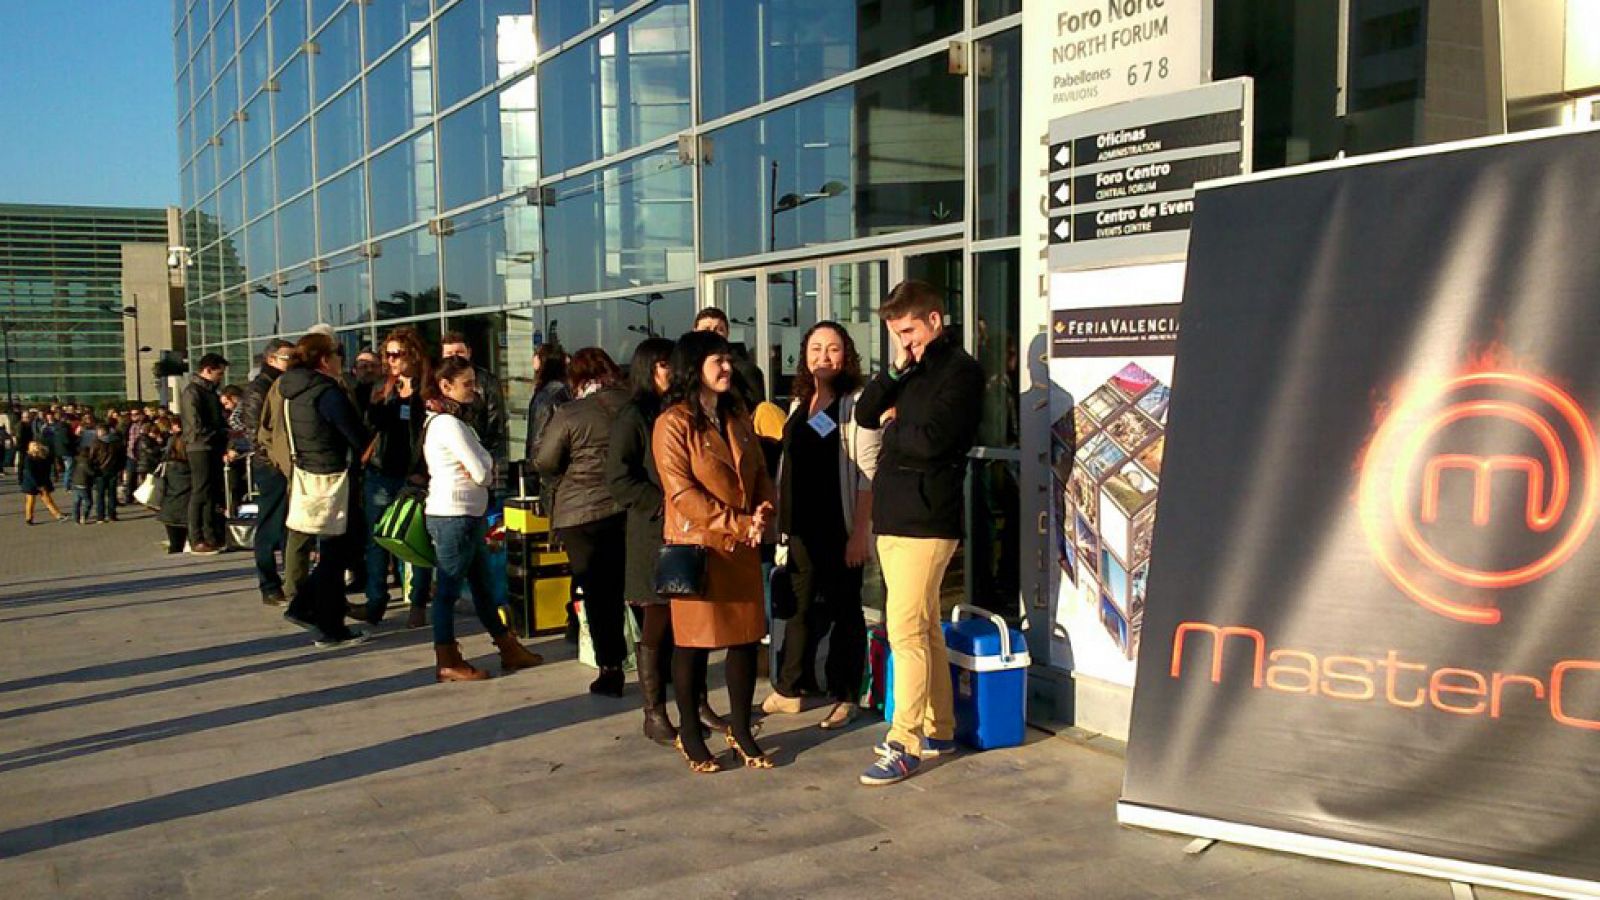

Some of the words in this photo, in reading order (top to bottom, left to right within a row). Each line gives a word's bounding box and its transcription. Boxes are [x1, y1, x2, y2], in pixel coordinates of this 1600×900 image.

[1057, 8, 1102, 36] Foro
[1052, 33, 1107, 64] NORTH
[1111, 15, 1168, 50] FORUM
[1052, 68, 1111, 88] Pabellones
[1096, 128, 1147, 148] Oficinas
[1096, 171, 1123, 187] Foro
[1126, 163, 1171, 181] Centro
[1096, 208, 1137, 225] Centro
[1140, 203, 1157, 219] de
